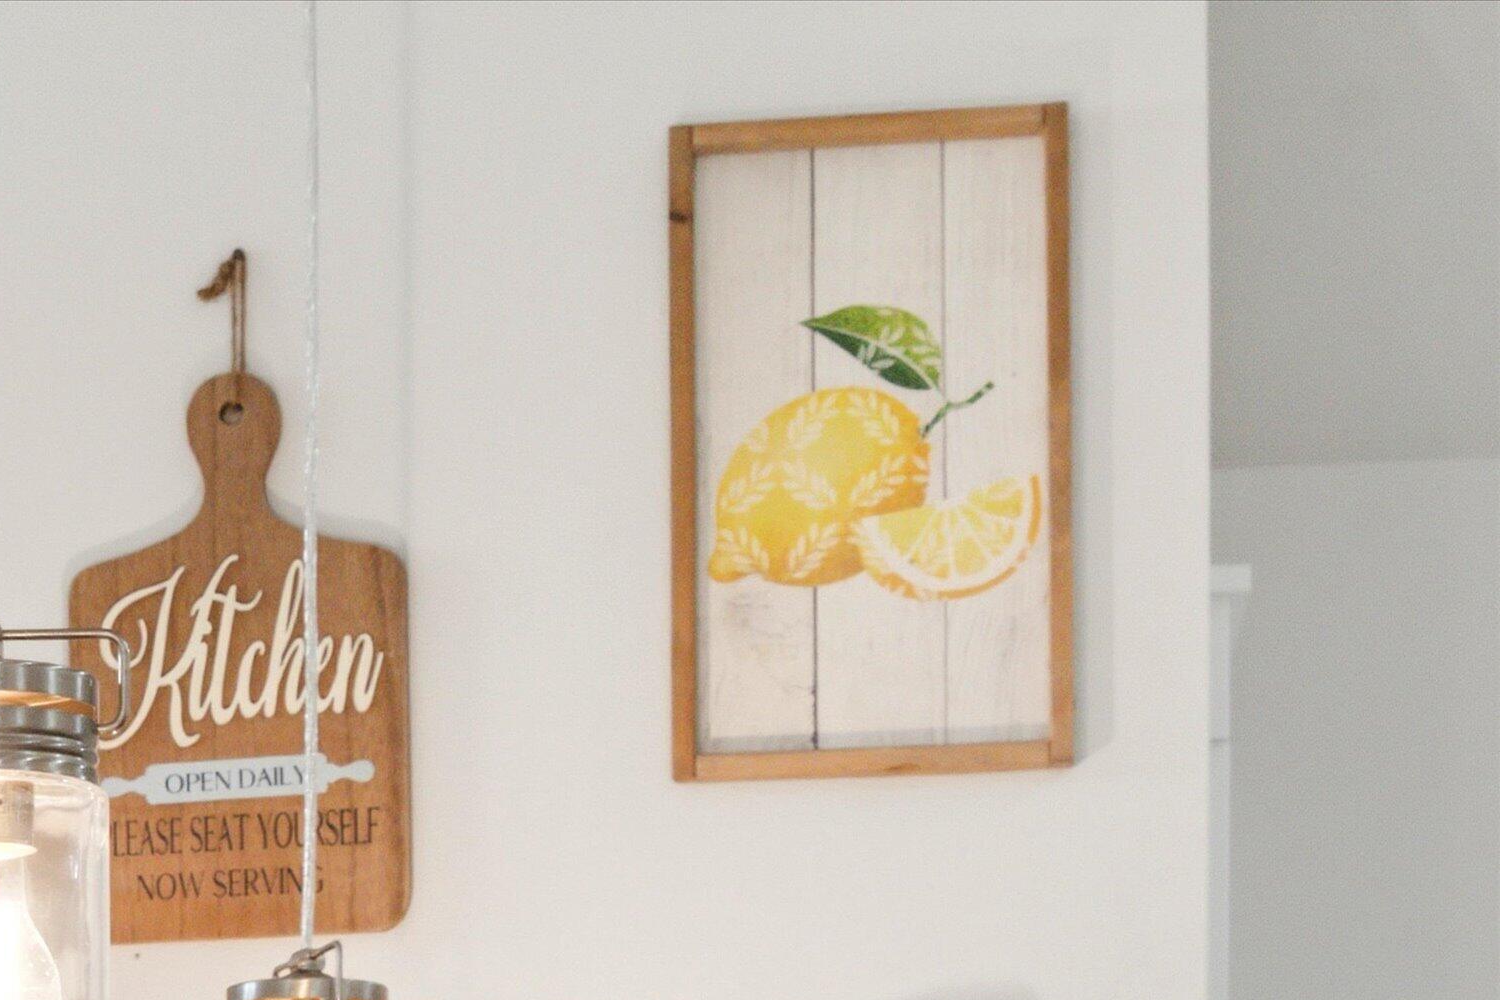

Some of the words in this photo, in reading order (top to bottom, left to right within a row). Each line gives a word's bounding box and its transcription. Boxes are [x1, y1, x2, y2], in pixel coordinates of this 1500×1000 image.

[99, 554, 383, 750] Kitchen
[165, 770, 232, 794] OPEN
[239, 765, 307, 789] DAILY
[109, 817, 182, 857] LEASE
[190, 814, 250, 851] SEAT
[137, 872, 201, 900] NOW
